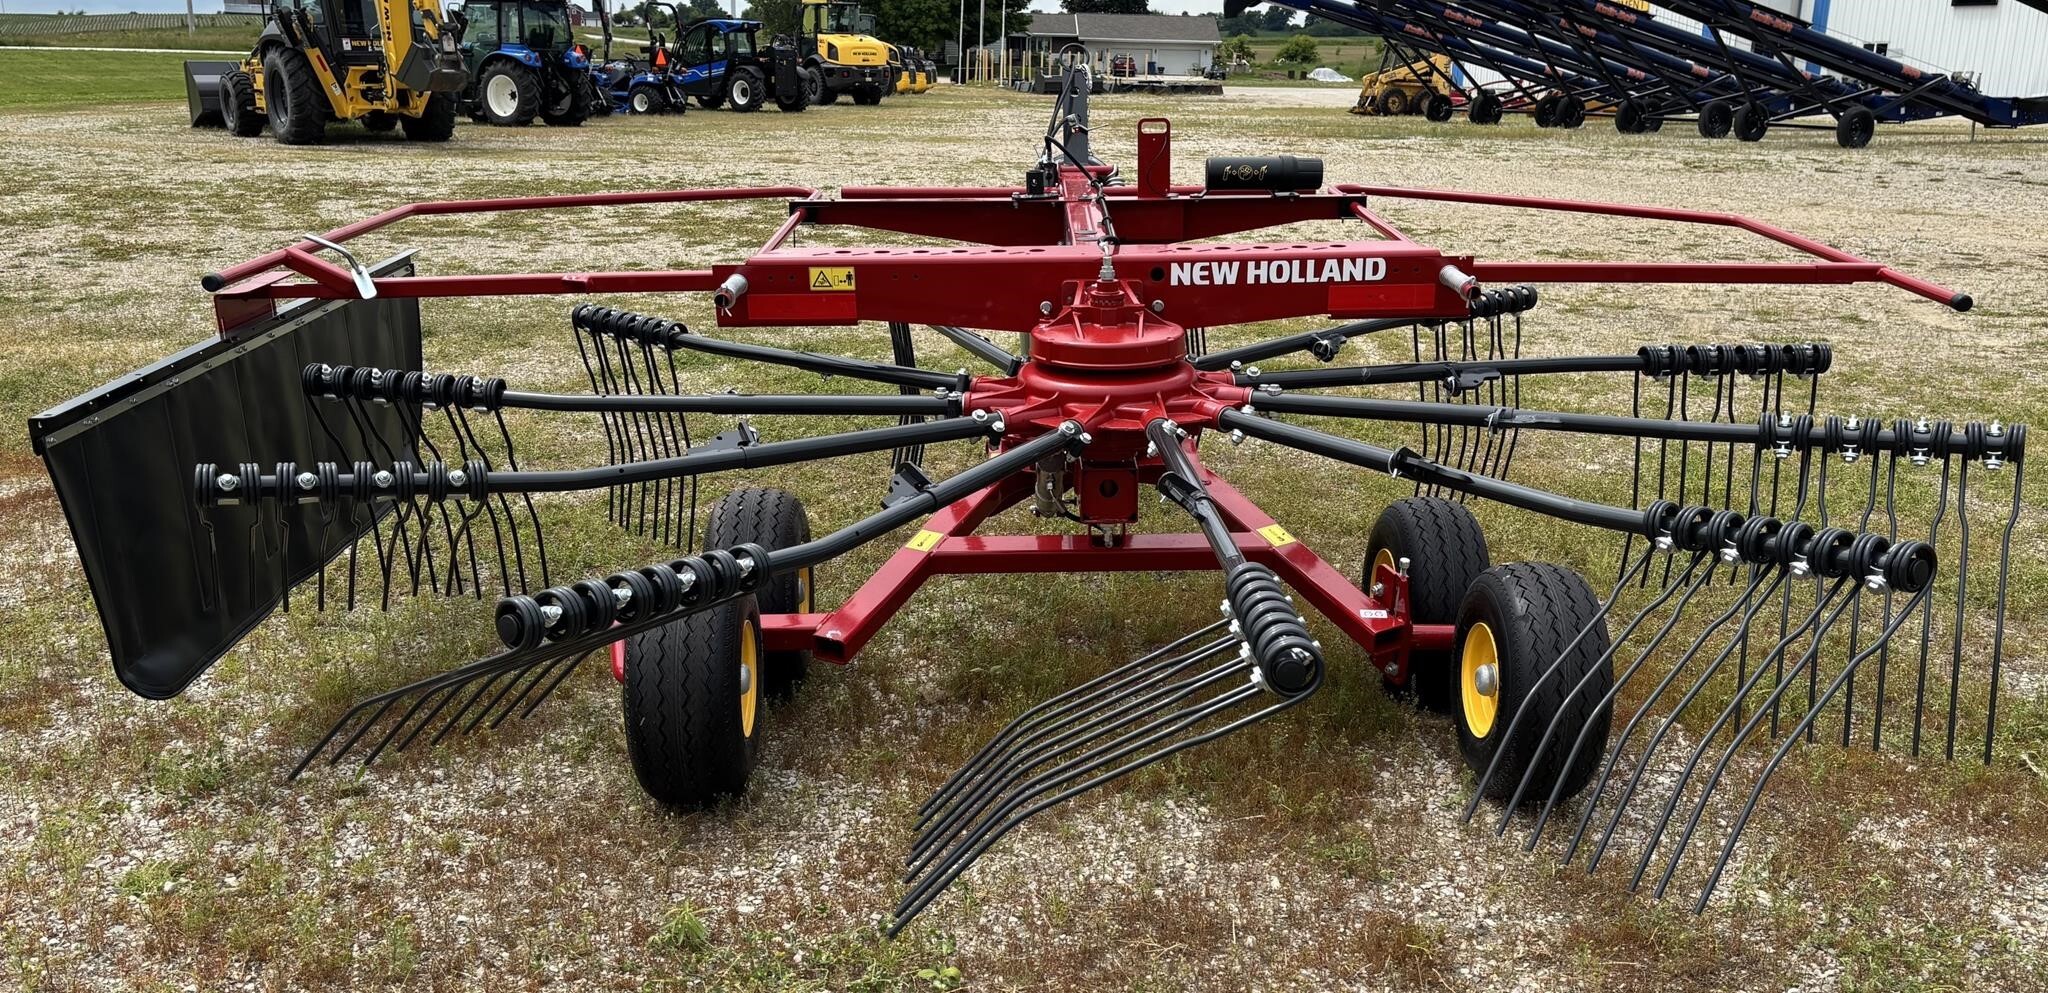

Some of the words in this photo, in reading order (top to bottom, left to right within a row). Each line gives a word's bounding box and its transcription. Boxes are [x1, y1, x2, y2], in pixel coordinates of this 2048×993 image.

[384, 6, 392, 41] NEW
[1170, 261, 1240, 286] NEW
[1246, 257, 1387, 284] HOLLAND
